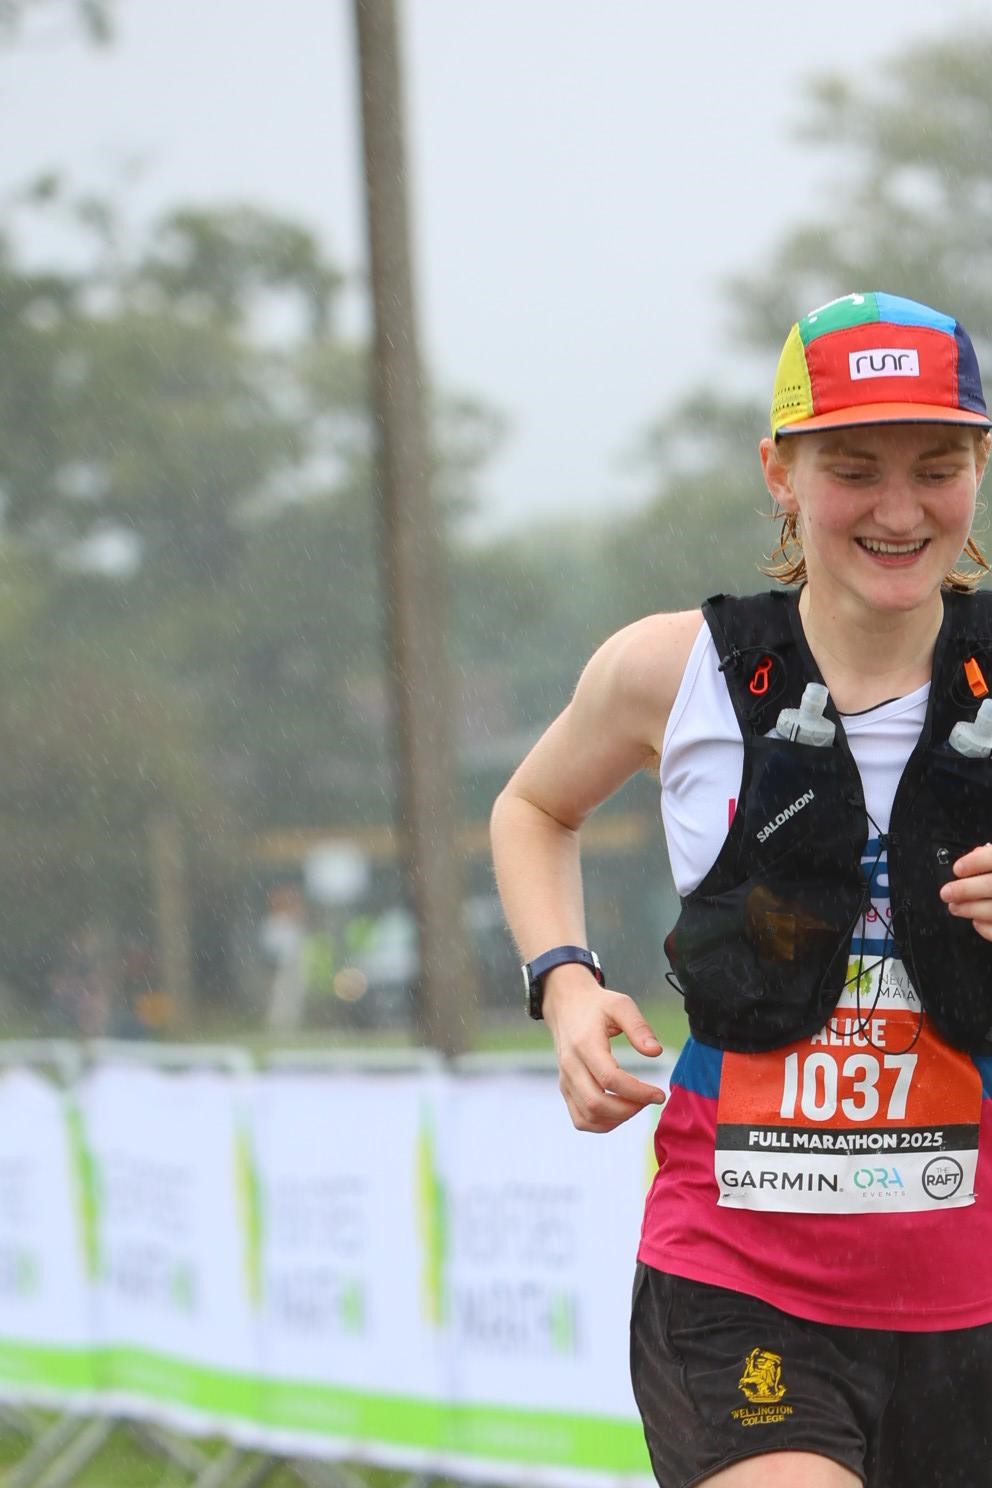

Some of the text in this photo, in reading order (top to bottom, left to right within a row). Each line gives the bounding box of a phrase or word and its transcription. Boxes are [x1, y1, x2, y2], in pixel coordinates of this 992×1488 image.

[757, 789, 815, 843] SALOMON
[811, 1018, 886, 1047] ALICE
[779, 1052, 918, 1122] 1037
[749, 1130, 944, 1150] FULL MARATHON 2025
[721, 1169, 838, 1192] GARMIN
[853, 1167, 905, 1189] ORA
[926, 1173, 960, 1186] RAFT
[731, 1405, 793, 1420] WELLINGTON
[741, 1414, 785, 1427] COLLEGE
